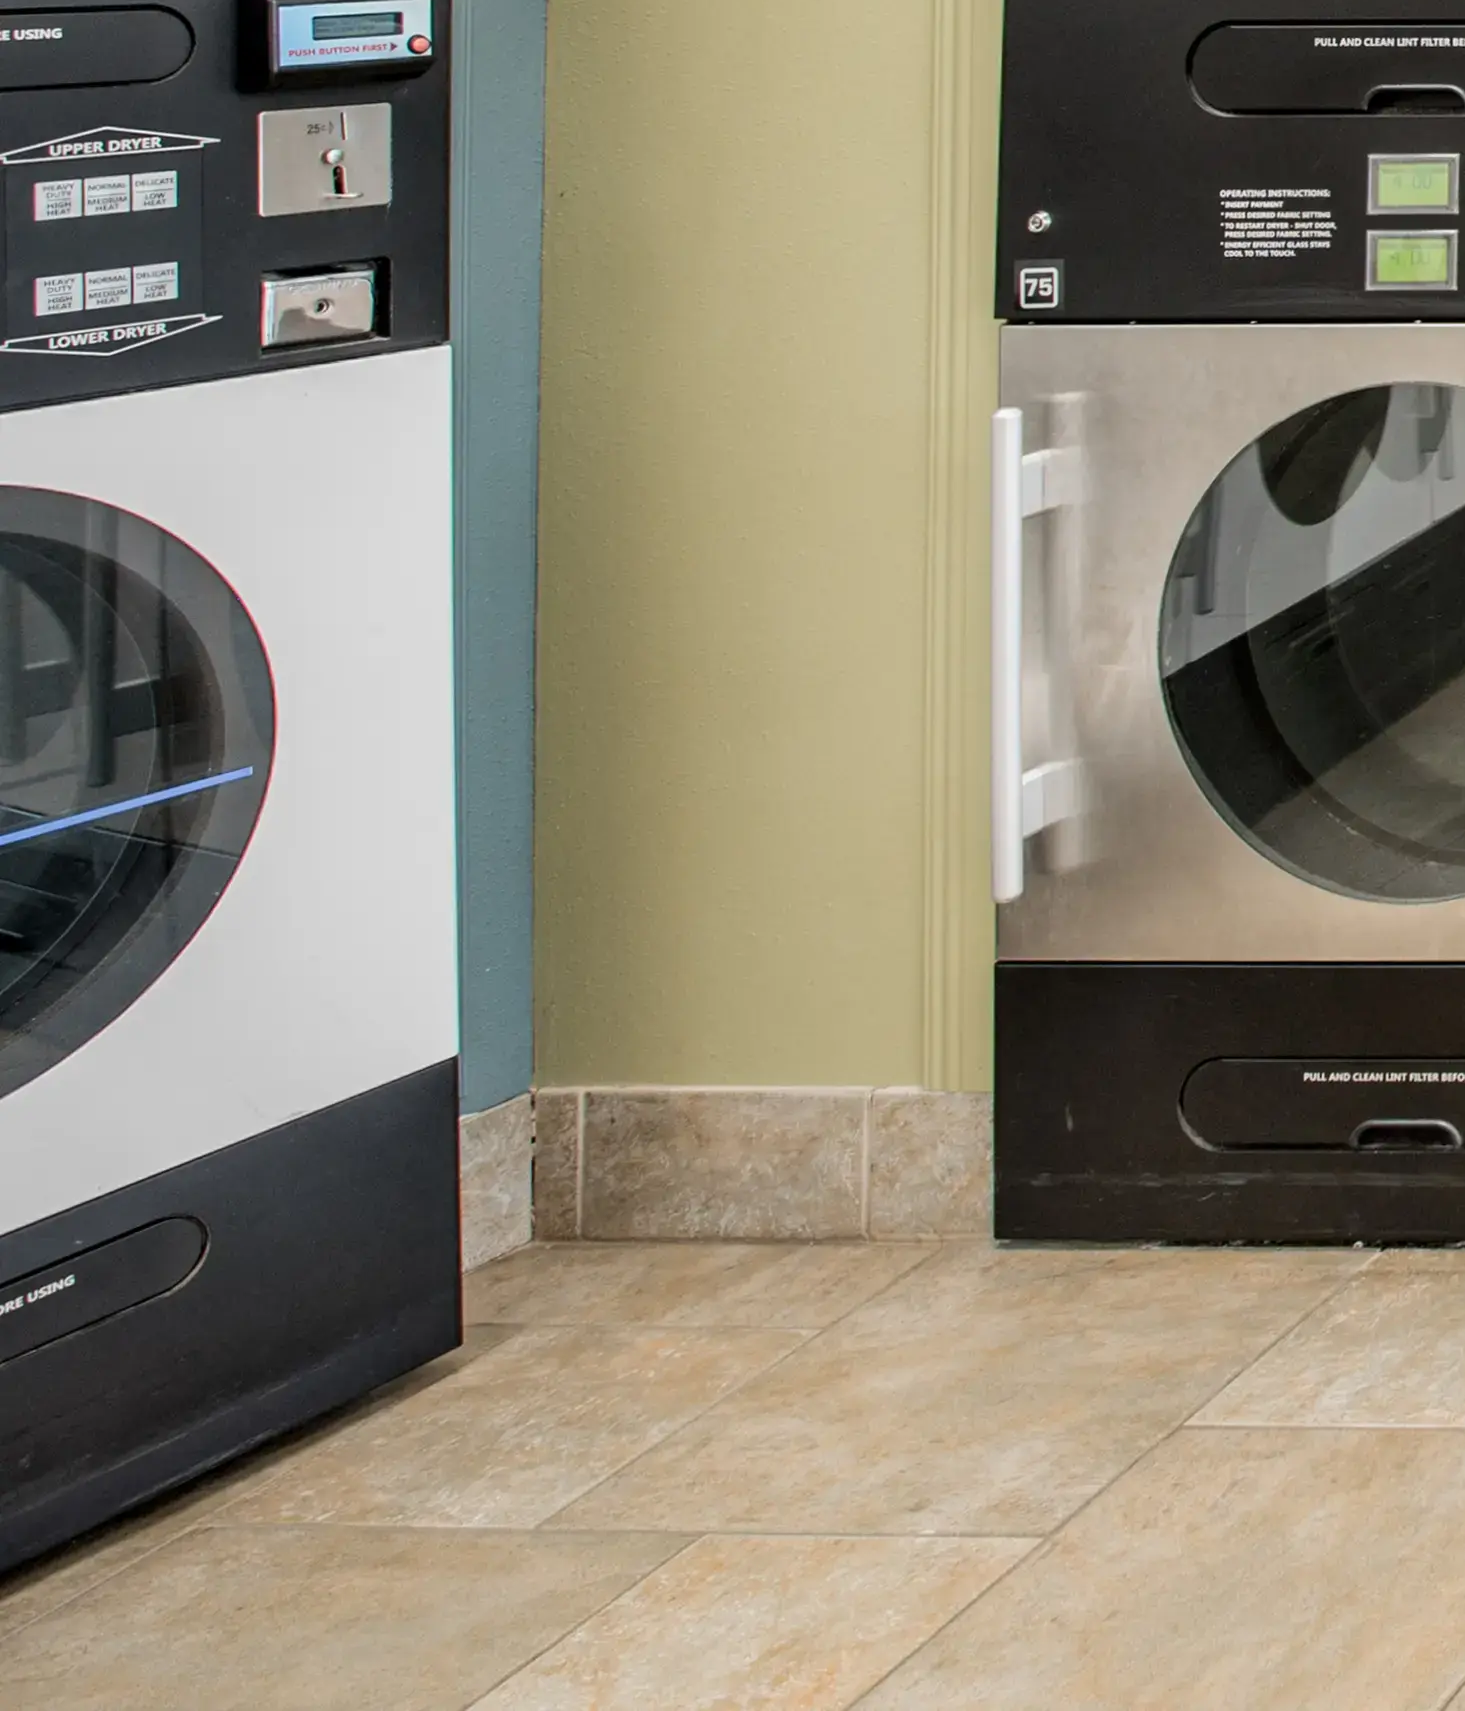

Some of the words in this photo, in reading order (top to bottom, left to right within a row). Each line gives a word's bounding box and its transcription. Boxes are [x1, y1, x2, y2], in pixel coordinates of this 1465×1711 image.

[13, 28, 63, 40] USING
[1314, 37, 1339, 47] PULL
[1339, 37, 1363, 47] AND
[1363, 37, 1396, 47] CLEAN
[1396, 37, 1420, 47] LINT
[1420, 37, 1451, 47] FILTER
[288, 49, 316, 57] PUSH
[318, 46, 360, 55] BUTTON
[362, 44, 388, 52] FIRST
[49, 140, 104, 157] UPPER
[107, 137, 162, 152] DRYER
[135, 177, 174, 187] DELICATE
[145, 192, 166, 201] LOW
[1219, 189, 1267, 198] OPERATING
[1267, 189, 1331, 198] INSTRUCTIONS:
[95, 203, 119, 212] HEAT
[143, 199, 167, 207] HEAT
[1224, 201, 1250, 209] INSERT
[1250, 200, 1284, 209] PAYMENT
[1223, 249, 1244, 258] COOL
[1243, 249, 1255, 258] TO
[1254, 249, 1269, 258] THE
[135, 268, 175, 279] DELICATE
[43, 278, 76, 287] HEAVY
[88, 274, 128, 284] NORMAL
[46, 285, 73, 293] DUTY
[1025, 277, 1054, 297] 75
[88, 289, 128, 300] MEDIUM
[47, 296, 73, 304] HIGH
[96, 296, 120, 305] HEAT
[49, 330, 110, 349] LOWER
[113, 322, 167, 341] DRYER
[1303, 1071, 1328, 1082] PULL
[1328, 1071, 1352, 1082] AND
[1352, 1072, 1384, 1082] CLEAN
[1385, 1072, 1408, 1082] LINT
[1408, 1072, 1440, 1083] FILTER
[26, 1274, 75, 1303] USING
